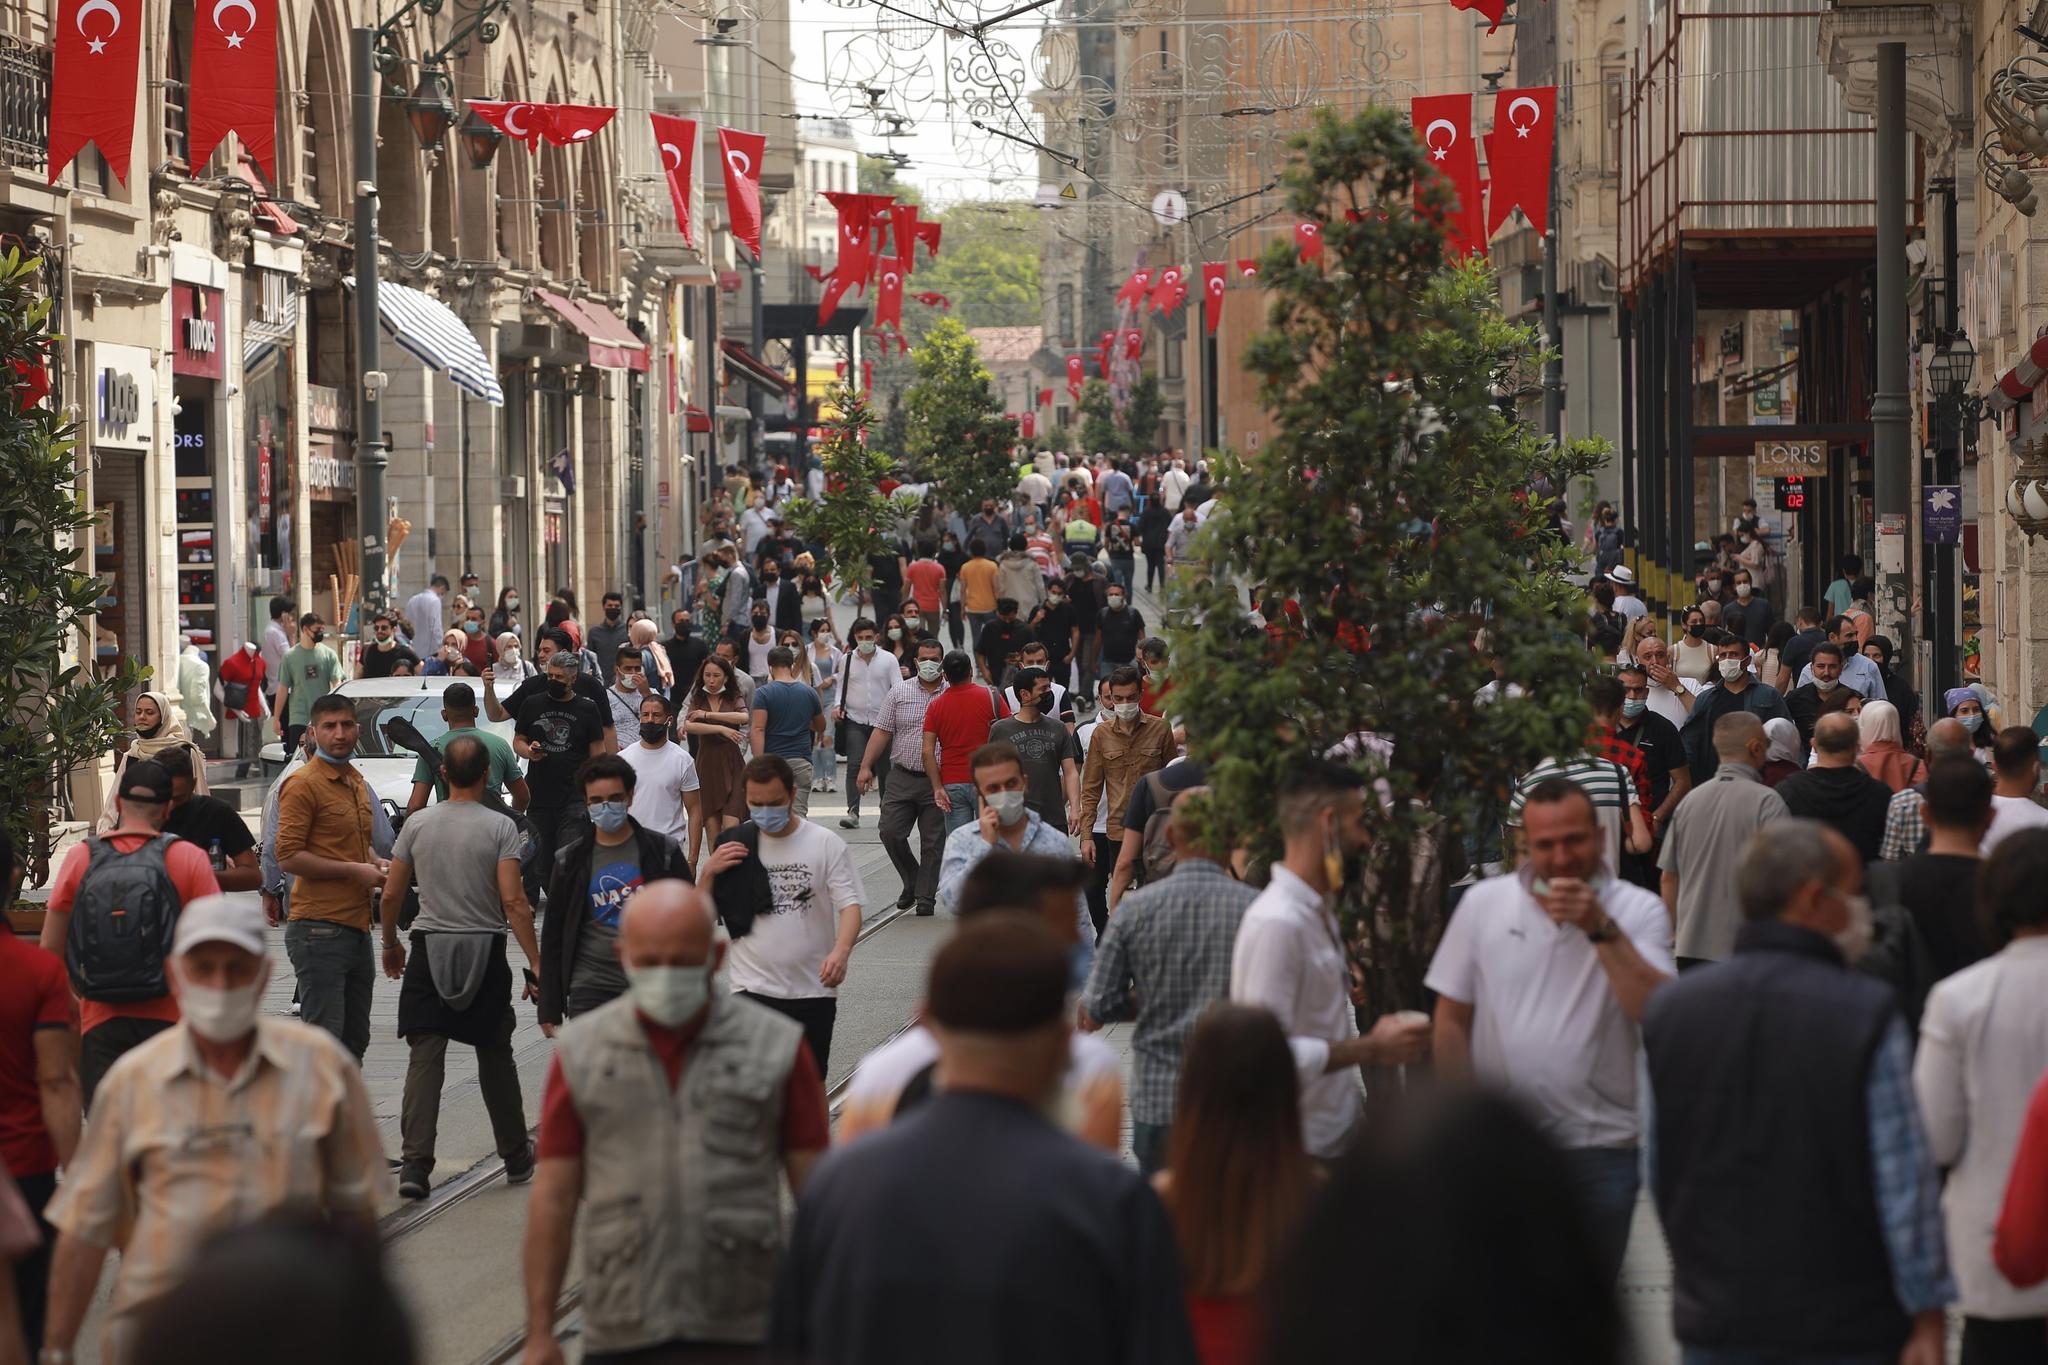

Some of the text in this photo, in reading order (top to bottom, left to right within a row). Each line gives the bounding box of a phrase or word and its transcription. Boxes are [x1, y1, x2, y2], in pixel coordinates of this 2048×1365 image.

[189, 318, 215, 352] TUDORS
[174, 434, 204, 448] ORS
[1762, 446, 1821, 464] LORIS
[1788, 494, 1804, 508] 02
[1009, 729, 1056, 743] TOM TAILOR
[591, 885, 643, 908] NAS
